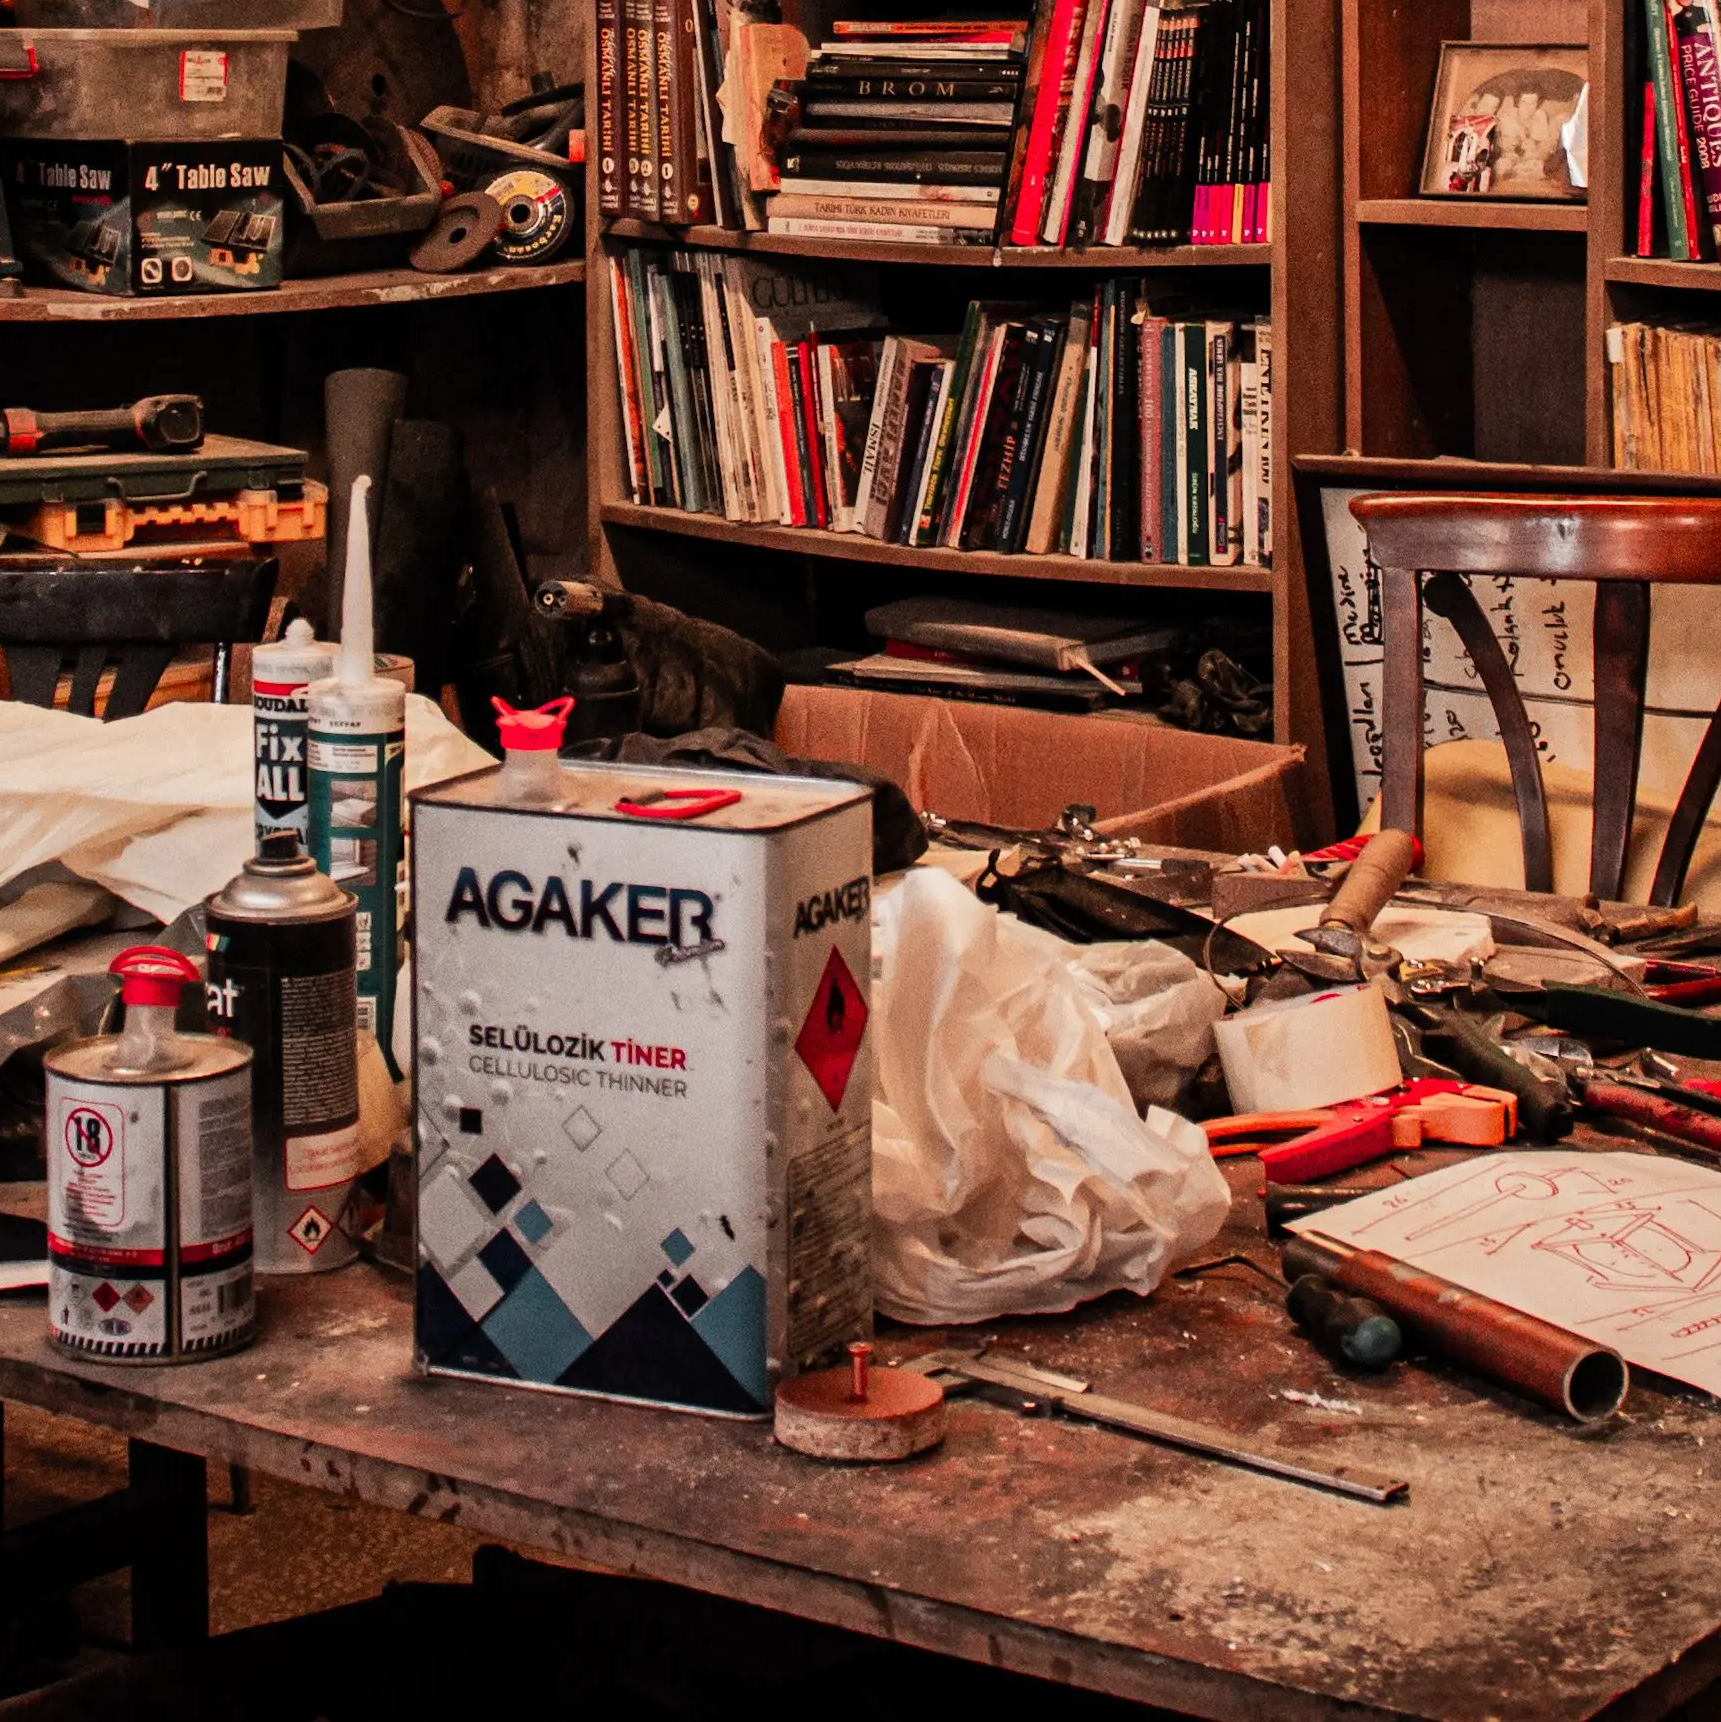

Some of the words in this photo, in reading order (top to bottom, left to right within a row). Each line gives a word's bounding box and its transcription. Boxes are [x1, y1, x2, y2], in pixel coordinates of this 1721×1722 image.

[601, 28, 613, 95] OSMANLI
[626, 28, 637, 95] OSMANLI
[637, 29, 649, 96] OSMANLI
[656, 31, 668, 100] OSMANLI
[1679, 45, 1697, 86] PRICE
[858, 80, 955, 98] BROM
[602, 98, 613, 151] TARİHİ
[660, 104, 671, 157] TARİHİ
[1687, 89, 1704, 133] GUIDE
[1695, 138, 1711, 169] 2008
[38, 162, 76, 189] Table
[79, 162, 111, 190] Saw
[175, 164, 225, 191] Table
[229, 162, 270, 188] Saw
[254, 695, 308, 713] OUDAL
[256, 723, 304, 761] Fix
[256, 763, 306, 801] ALL
[445, 866, 721, 949] AGAKER
[469, 1022, 605, 1062] SELÜLOZİK
[610, 1039, 687, 1072] TİNER
[468, 1057, 591, 1088] CELLULOSIC
[595, 1072, 688, 1099] THINNER
[73, 1115, 103, 1155] 18
